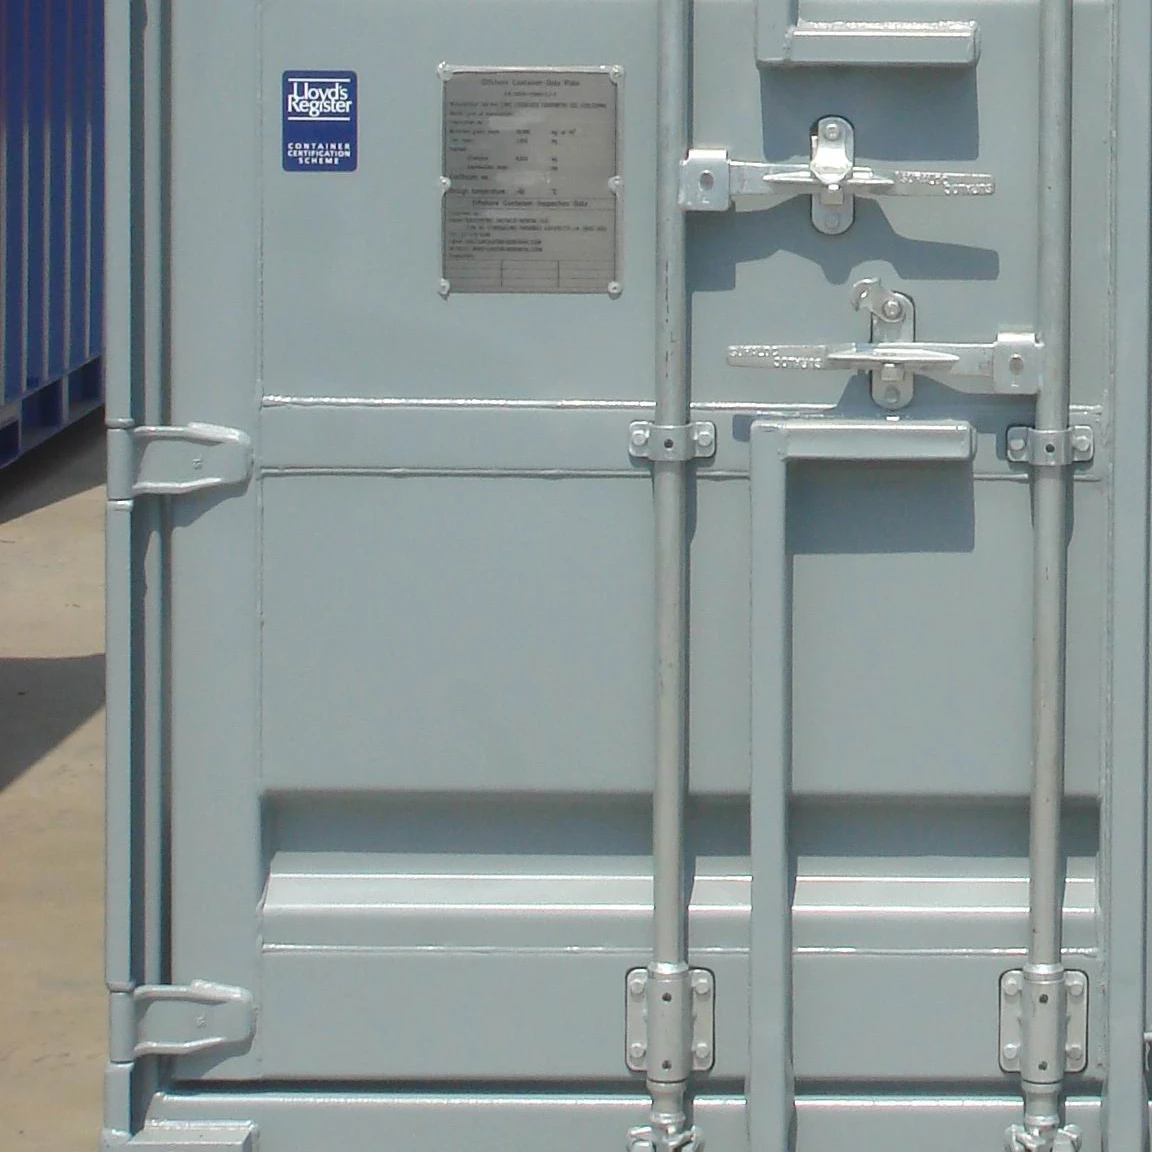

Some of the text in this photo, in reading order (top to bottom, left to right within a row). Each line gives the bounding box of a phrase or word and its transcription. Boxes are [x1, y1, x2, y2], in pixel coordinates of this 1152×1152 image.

[293, 82, 348, 101] Lloyd's
[287, 95, 353, 117] Register
[287, 142, 350, 150] CONTAINER
[298, 157, 340, 165] SCHEME
